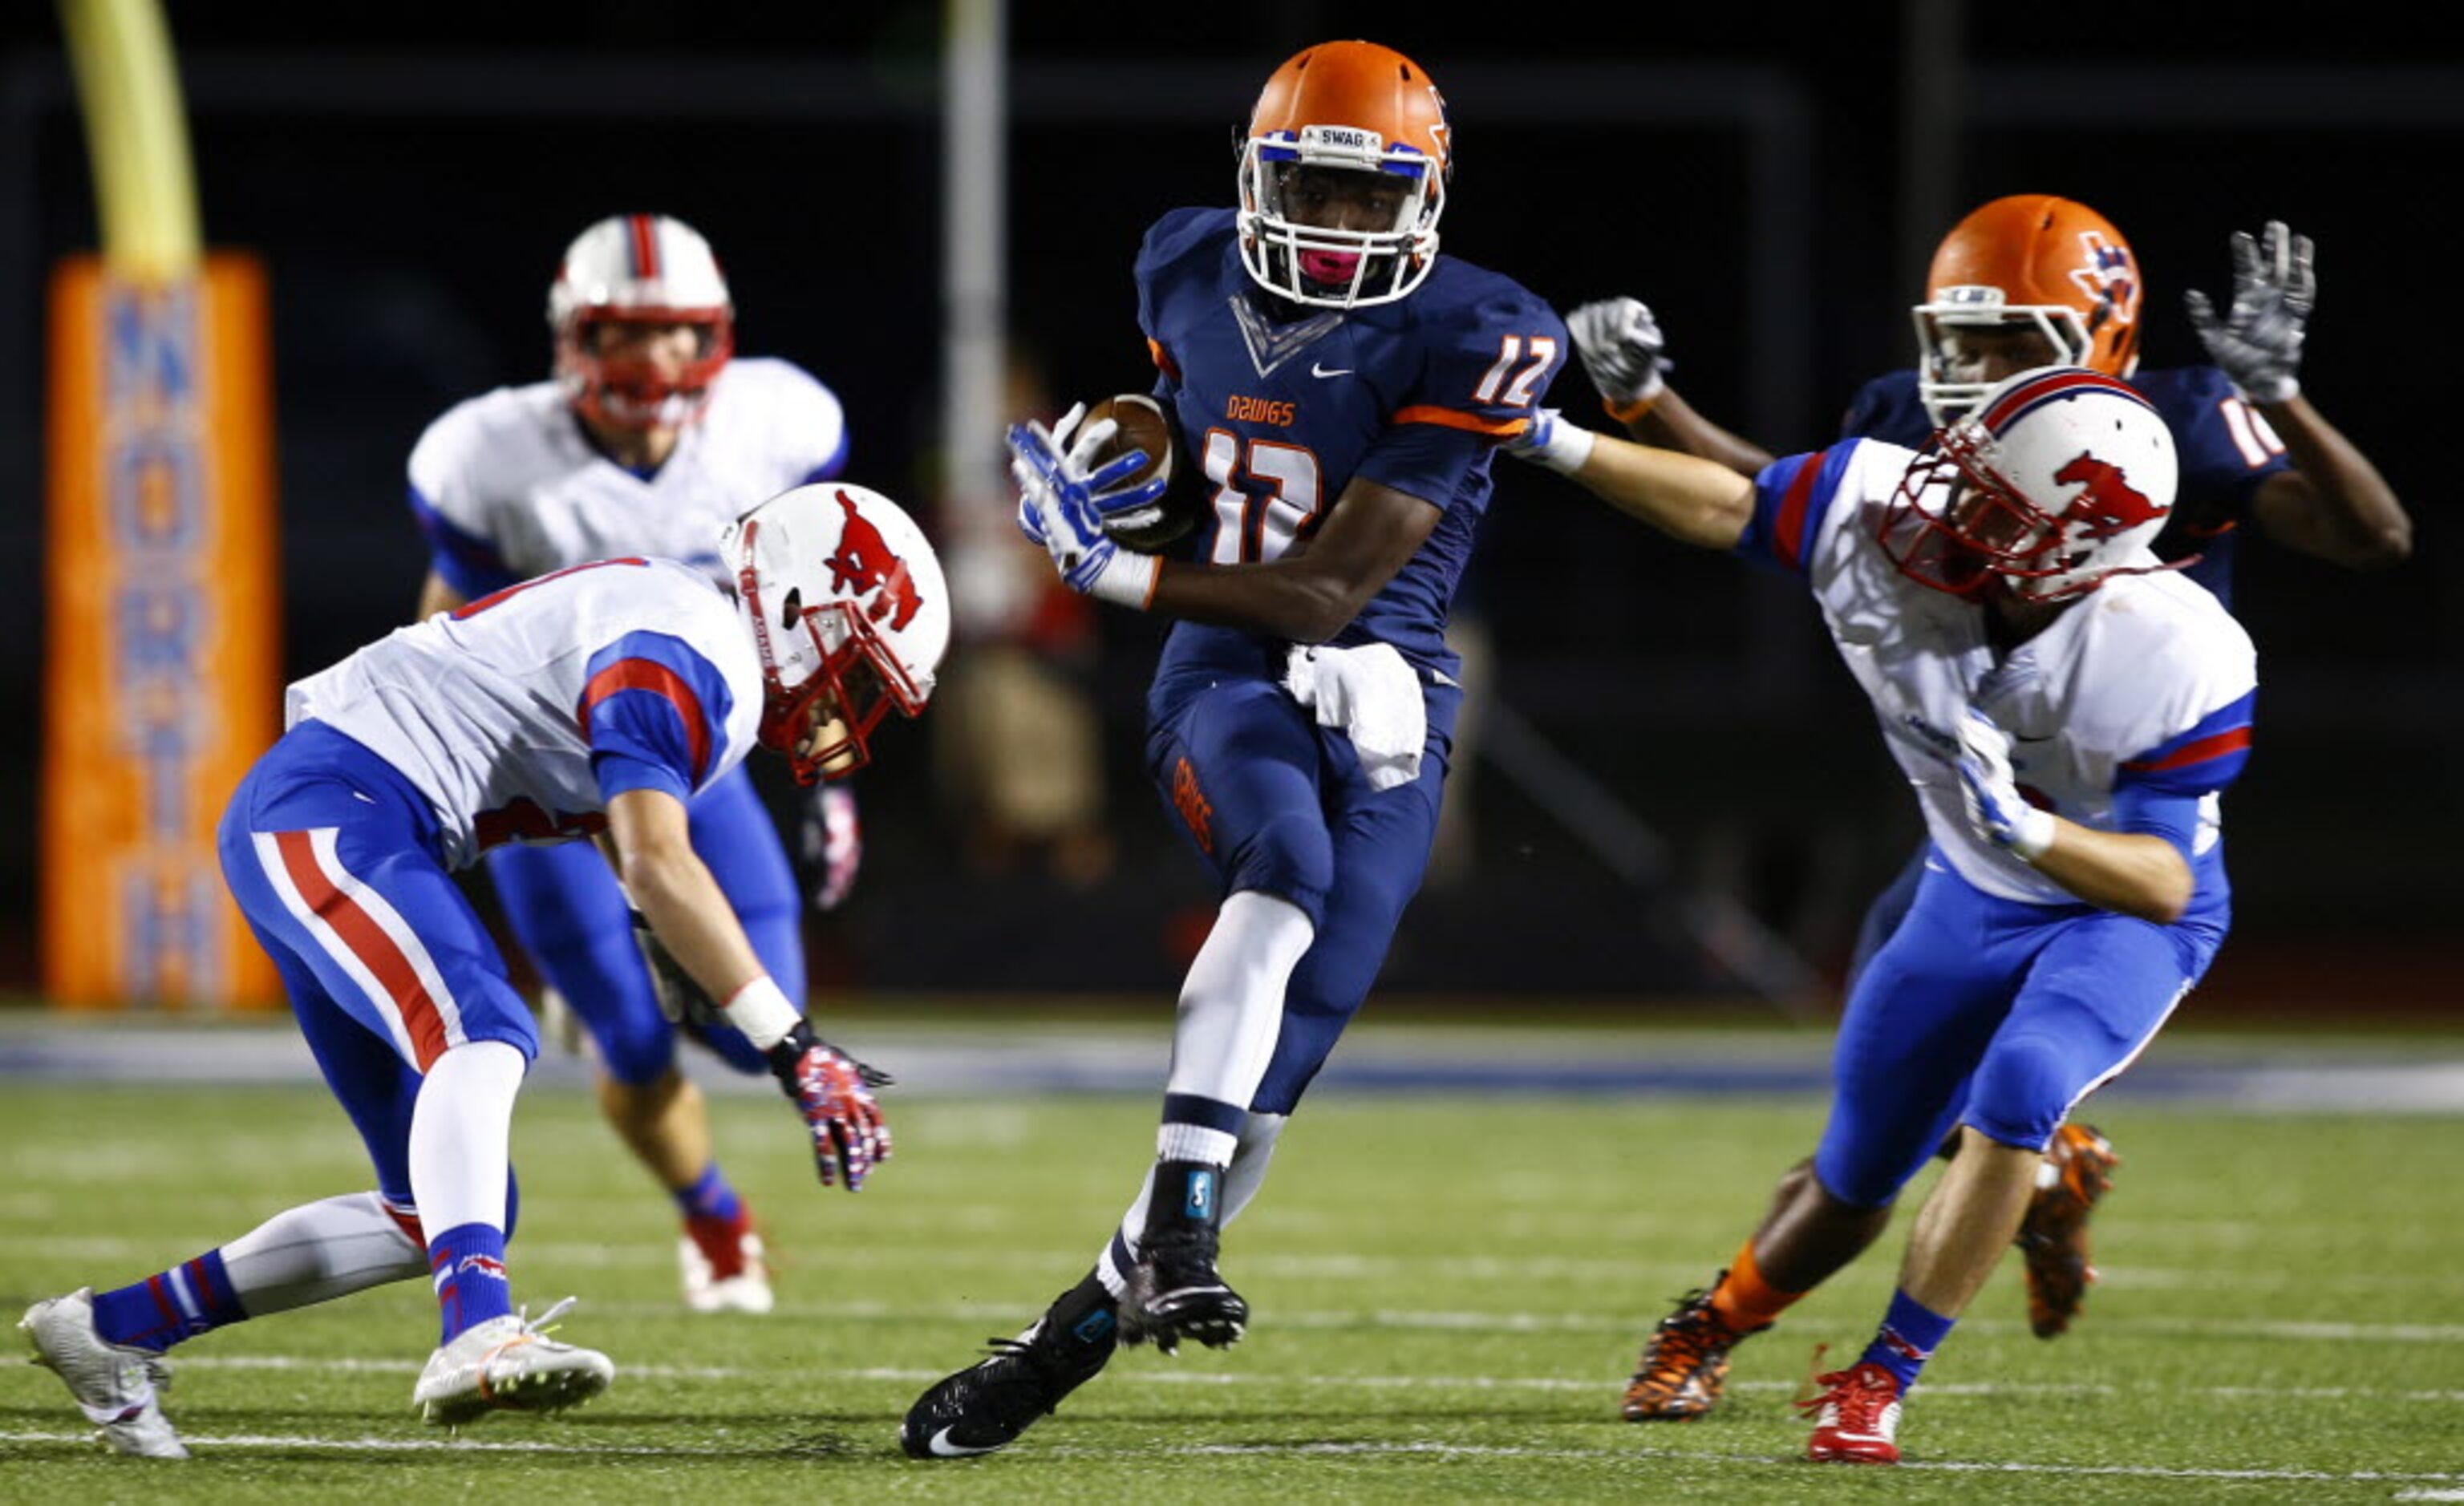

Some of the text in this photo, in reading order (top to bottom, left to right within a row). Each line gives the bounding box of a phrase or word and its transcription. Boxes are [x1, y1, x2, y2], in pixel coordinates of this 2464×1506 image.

[1323, 129, 1364, 148] SWAG
[1472, 334, 1556, 409] 12
[102, 285, 226, 1007] NORTH
